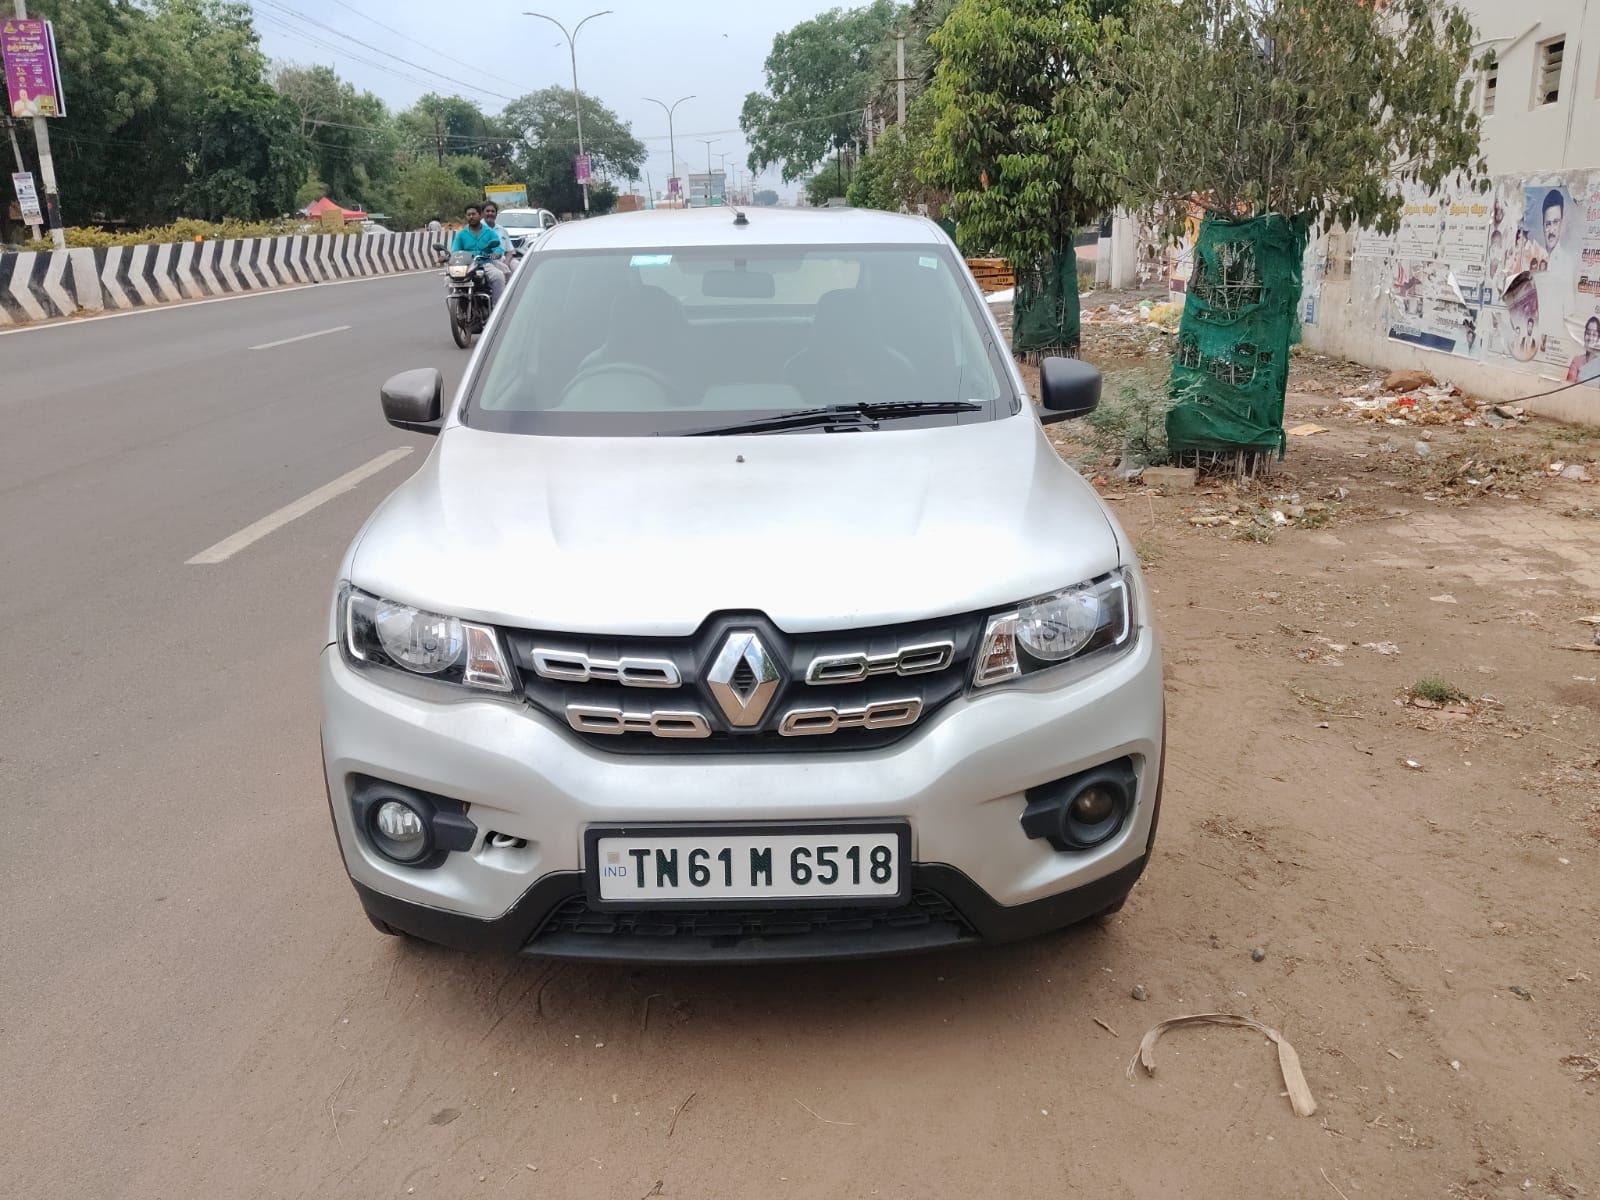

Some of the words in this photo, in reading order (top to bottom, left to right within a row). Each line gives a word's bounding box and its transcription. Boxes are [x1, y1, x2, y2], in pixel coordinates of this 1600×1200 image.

[603, 866, 627, 878] IND
[628, 847, 732, 888] TN61
[750, 847, 773, 887] M
[790, 845, 892, 885] 6518
